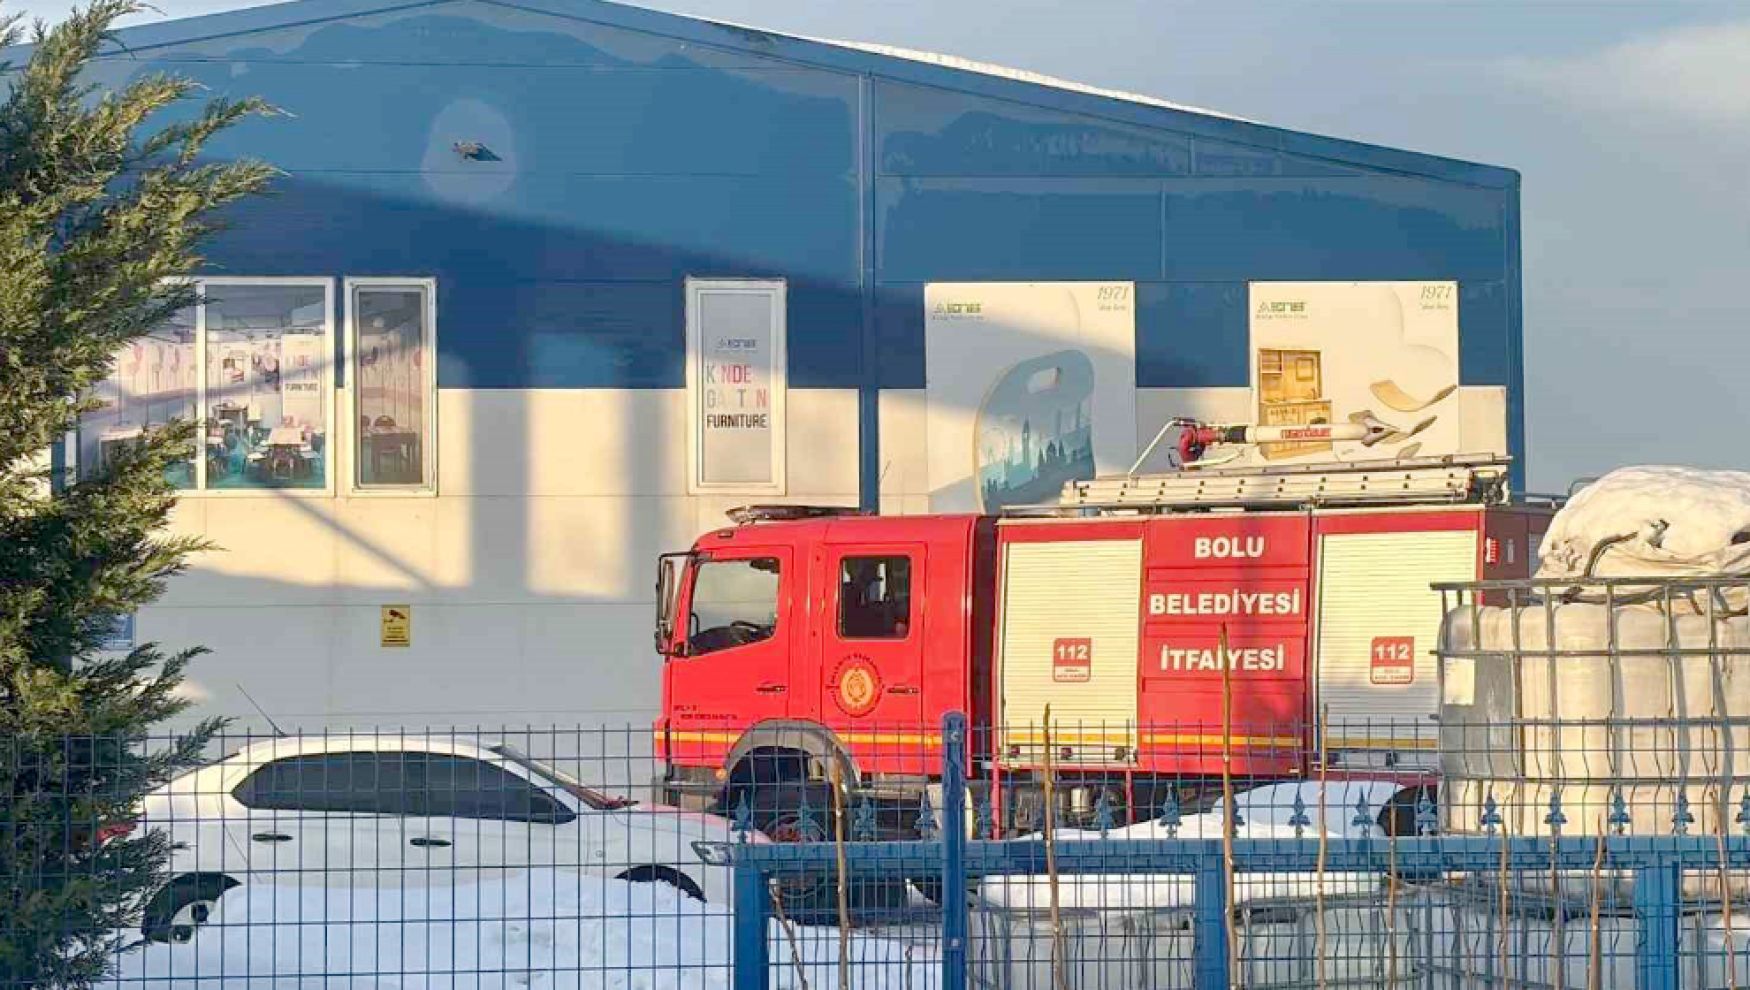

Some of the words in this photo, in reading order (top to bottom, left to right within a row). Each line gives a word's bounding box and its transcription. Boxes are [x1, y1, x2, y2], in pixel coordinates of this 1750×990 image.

[1097, 285, 1129, 300] 1971
[1420, 285, 1452, 300] 1971
[706, 413, 768, 429] FURNITURE
[1194, 536, 1265, 558] BOLU
[1149, 588, 1301, 615] BELEDİYESİ
[1058, 644, 1088, 660] 112
[1160, 644, 1285, 671] İTFAİYESİ
[1375, 643, 1409, 660] 112
